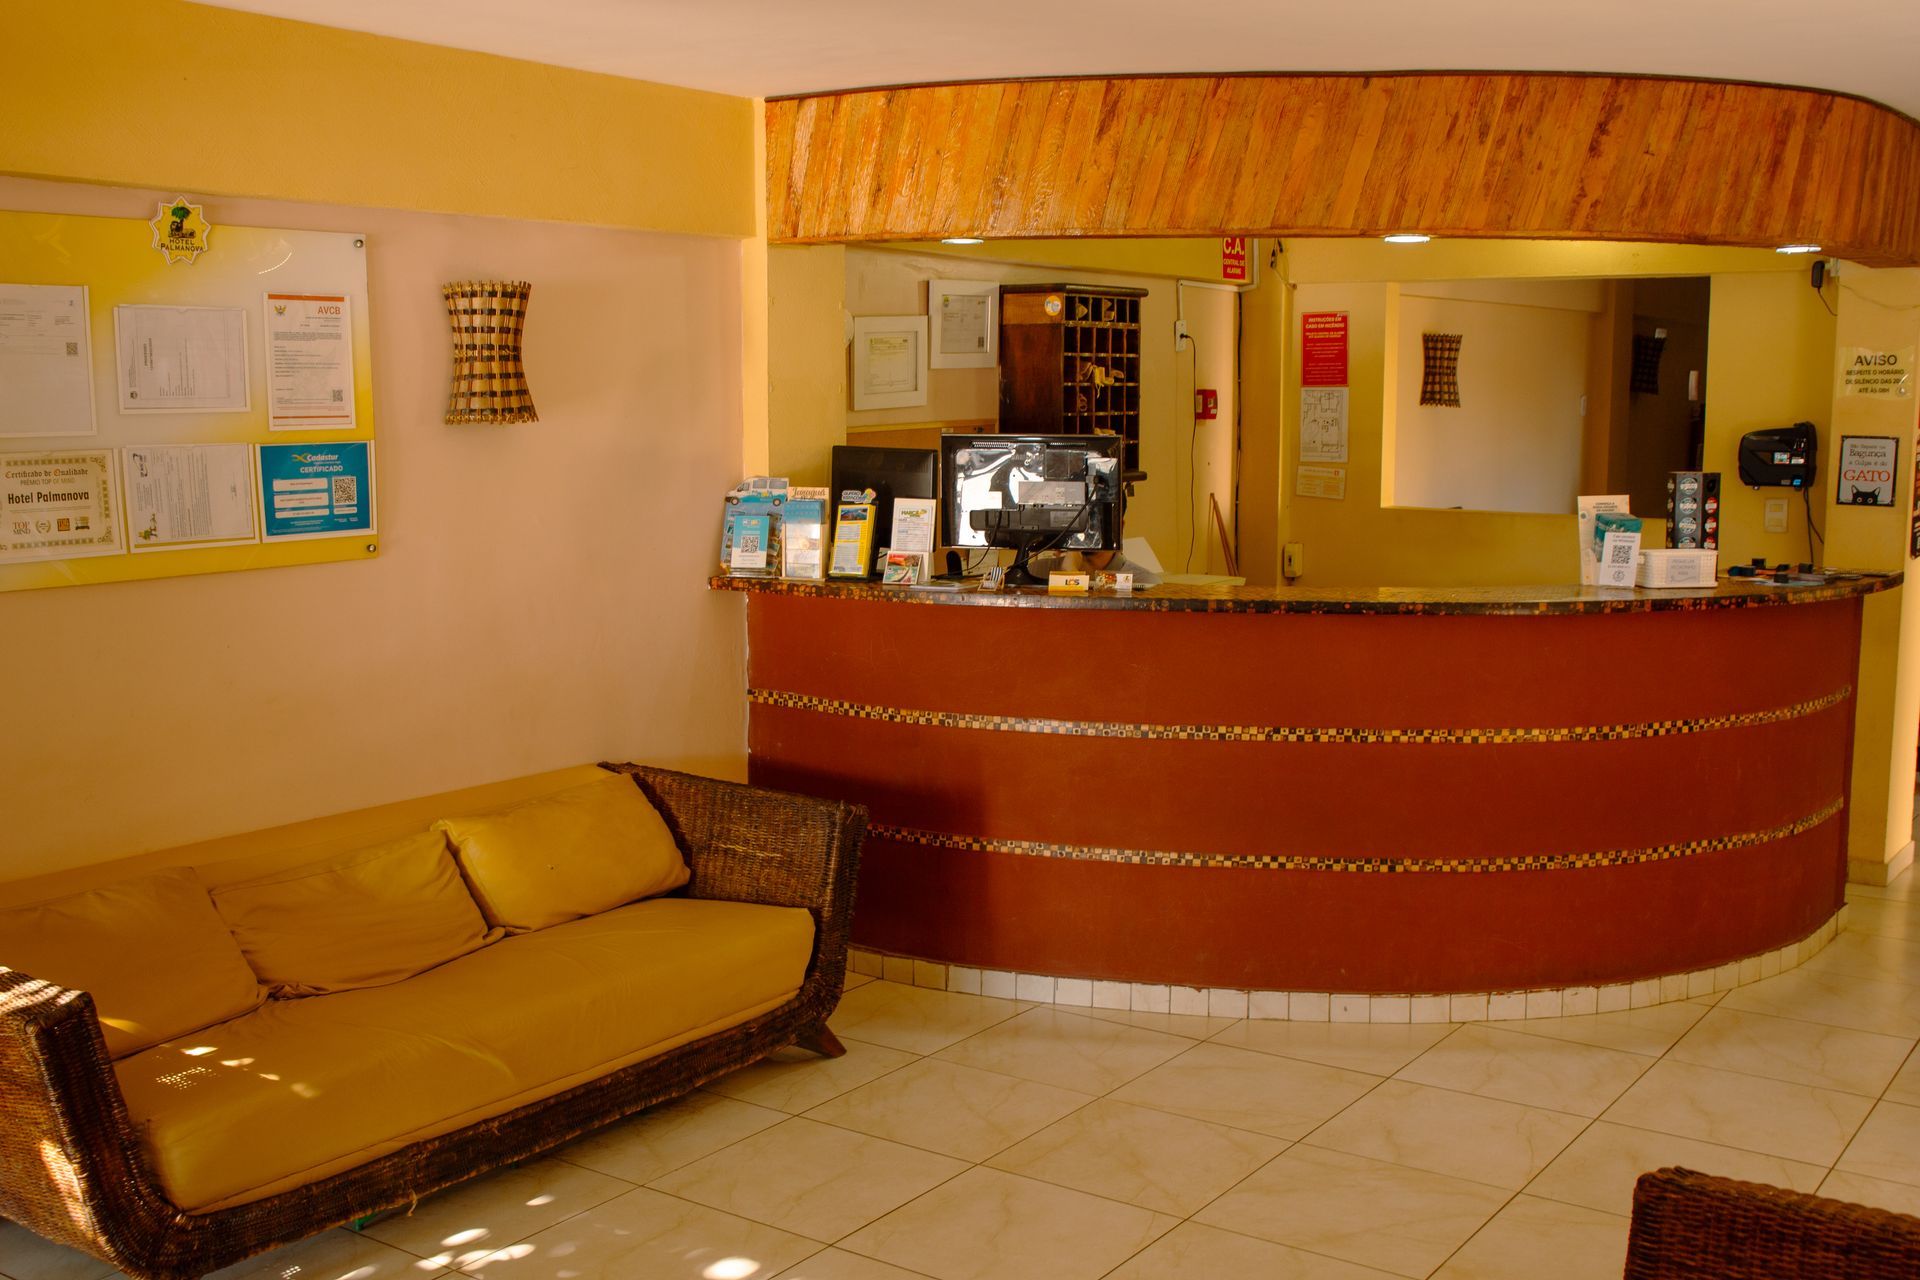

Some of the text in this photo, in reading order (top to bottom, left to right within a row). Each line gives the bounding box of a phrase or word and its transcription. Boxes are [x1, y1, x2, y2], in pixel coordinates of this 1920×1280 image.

[160, 242, 204, 252] PALMANOVA
[1224, 237, 1244, 255] C.A.
[318, 306, 341, 315] AVCB
[1854, 354, 1898, 366] AVISO
[1849, 449, 1886, 458] Bagunça
[300, 465, 343, 474] CERTIFICADO
[1844, 470, 1890, 482] GATO
[8, 490, 90, 504] Hotel Palmanova
